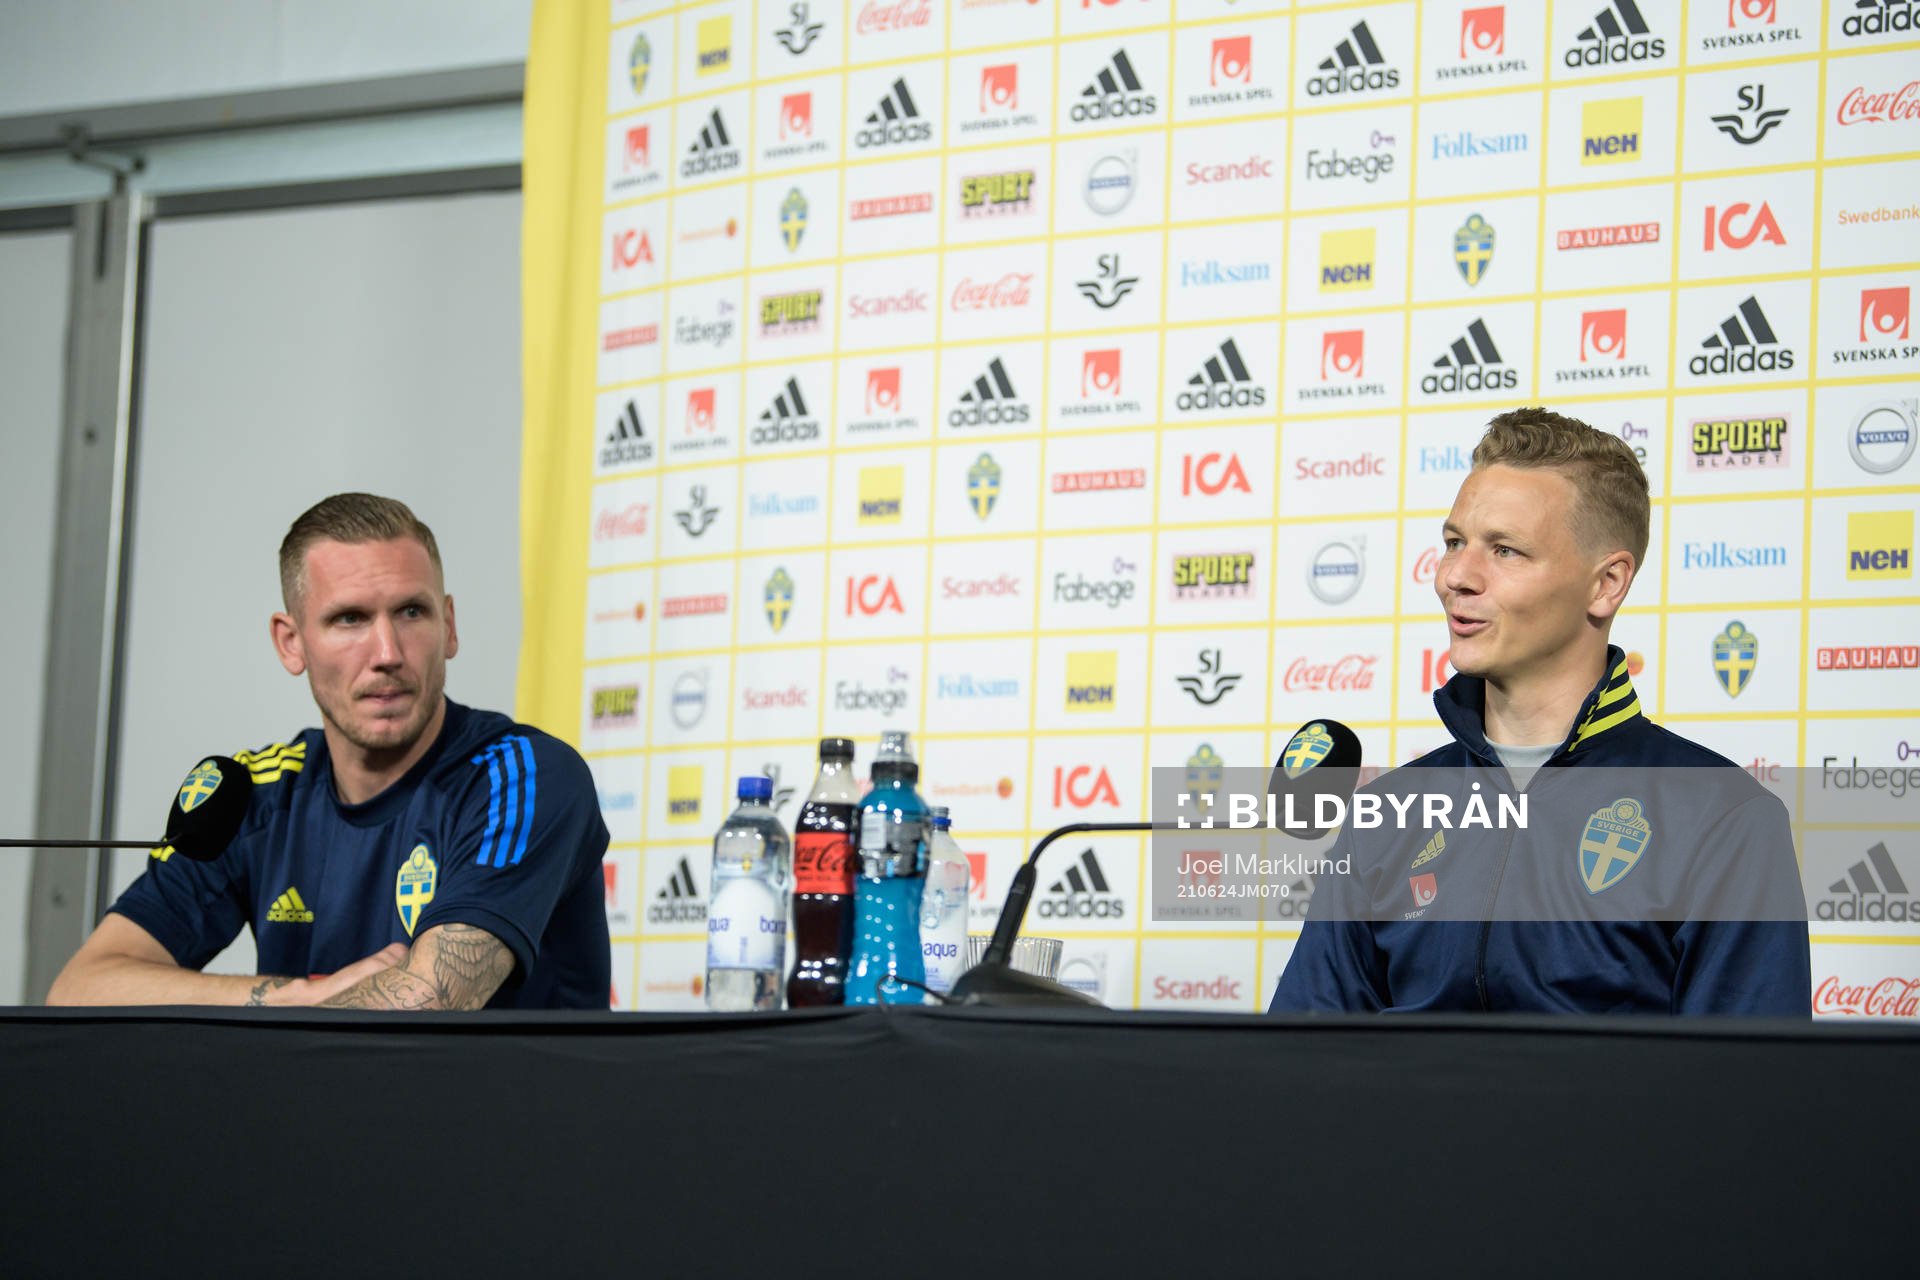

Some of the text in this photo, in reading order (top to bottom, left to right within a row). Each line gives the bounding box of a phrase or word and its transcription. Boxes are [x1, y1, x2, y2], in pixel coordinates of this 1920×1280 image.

[1565, 36, 1665, 68] adidas
[1703, 28, 1802, 50] SVENSKA SPEL
[1307, 66, 1399, 96] adidas
[1437, 60, 1527, 80] SVENSKA SPEL
[1071, 95, 1157, 122] adidas
[1189, 88, 1273, 107] SVENSKA SPEL
[1737, 84, 1764, 112] SJ
[856, 120, 932, 149] adidas
[1432, 131, 1527, 160] Folksam
[1187, 157, 1272, 185] Scandic
[1307, 149, 1393, 183] Fabege
[962, 172, 1035, 207] SPORT
[1704, 201, 1787, 252] ICA
[1839, 205, 1920, 224] Swedbank
[1558, 223, 1659, 250] BAUHAUS
[613, 229, 654, 272] ICA
[1098, 254, 1120, 278] SJ
[1181, 261, 1270, 288] Folksam
[848, 290, 927, 318] Scandic
[951, 273, 1034, 312] Coca-Cola
[1689, 346, 1794, 376] adidas
[1833, 348, 1897, 363] SVENSKA
[1422, 369, 1518, 394] adidas
[1555, 365, 1650, 382] SVENSKA SPEL
[1177, 386, 1266, 411] adidas
[1299, 383, 1385, 400] SVENSKA SPEL
[949, 404, 1030, 428] adidas
[1116, 402, 1141, 413] SPEL
[752, 422, 820, 445] adidas
[1692, 418, 1786, 455] SPORT
[1858, 431, 1908, 444] VOLVO
[1296, 453, 1385, 480] Scandic
[1696, 452, 1781, 468] BLADET
[1053, 469, 1146, 493] BAUHAUS
[1182, 453, 1252, 496] ICA
[1683, 541, 1787, 569] Folksam
[1174, 553, 1254, 587] SPORT
[846, 575, 904, 616] ICA
[943, 575, 1020, 599] Scandic
[1055, 573, 1134, 609] Fabege
[1199, 649, 1221, 673] SJ
[1284, 654, 1379, 693] Coca-Cola
[938, 674, 1019, 698] Folksam
[1053, 766, 1121, 809] ICA
[1823, 757, 1920, 797] Fabege
[1597, 821, 1639, 837] SVERIGE
[1038, 895, 1125, 919] adidas
[1405, 909, 1425, 920] SVENS
[1816, 894, 1920, 923] adidas
[1154, 975, 1241, 1000] Scandic
[1814, 976, 1920, 1017] Coca-Cola
